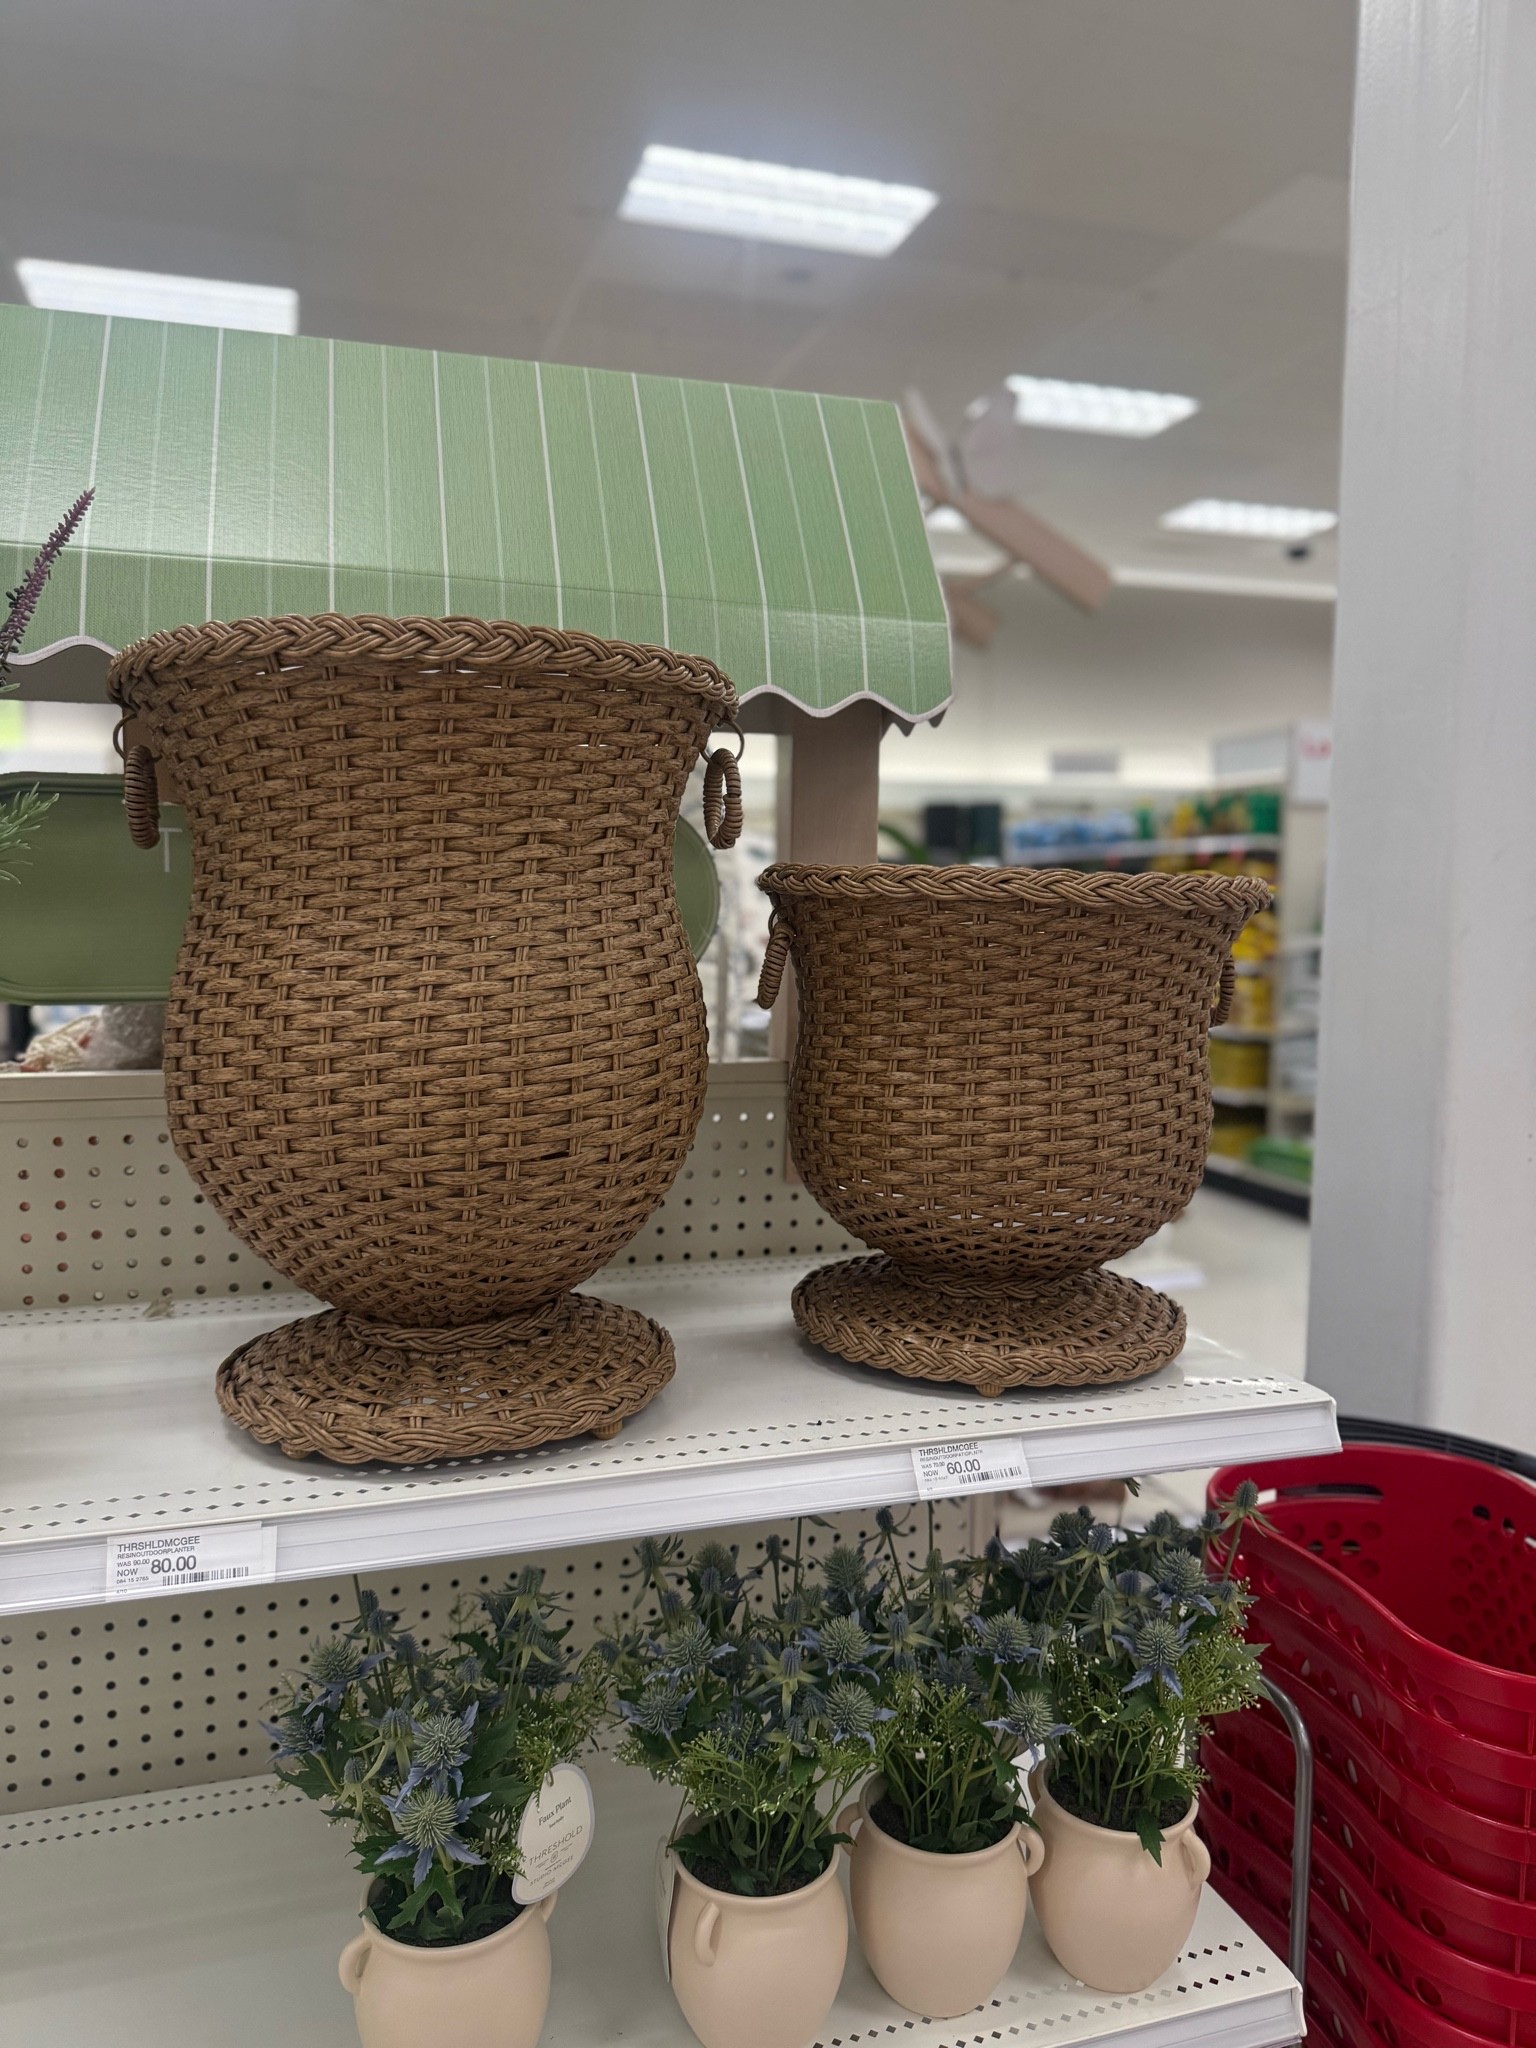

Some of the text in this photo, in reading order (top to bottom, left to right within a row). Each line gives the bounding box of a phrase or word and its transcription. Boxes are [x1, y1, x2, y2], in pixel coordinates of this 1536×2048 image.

[918, 1442, 979, 1457] THRSHLDMCGEE
[923, 1469, 938, 1477] NOW
[946, 1458, 981, 1475] 60.00
[117, 1535, 200, 1553] THRSHLDMCGEE
[117, 1545, 195, 1560] RESINOUTDOORPLANTER
[117, 1558, 150, 1568] WAS 90.00
[151, 1555, 197, 1574] 80.00
[117, 1568, 138, 1577] NOW
[538, 1809, 555, 1826] Faux
[555, 1796, 572, 1814] Plant
[529, 1825, 583, 1866] THRESHOLD
